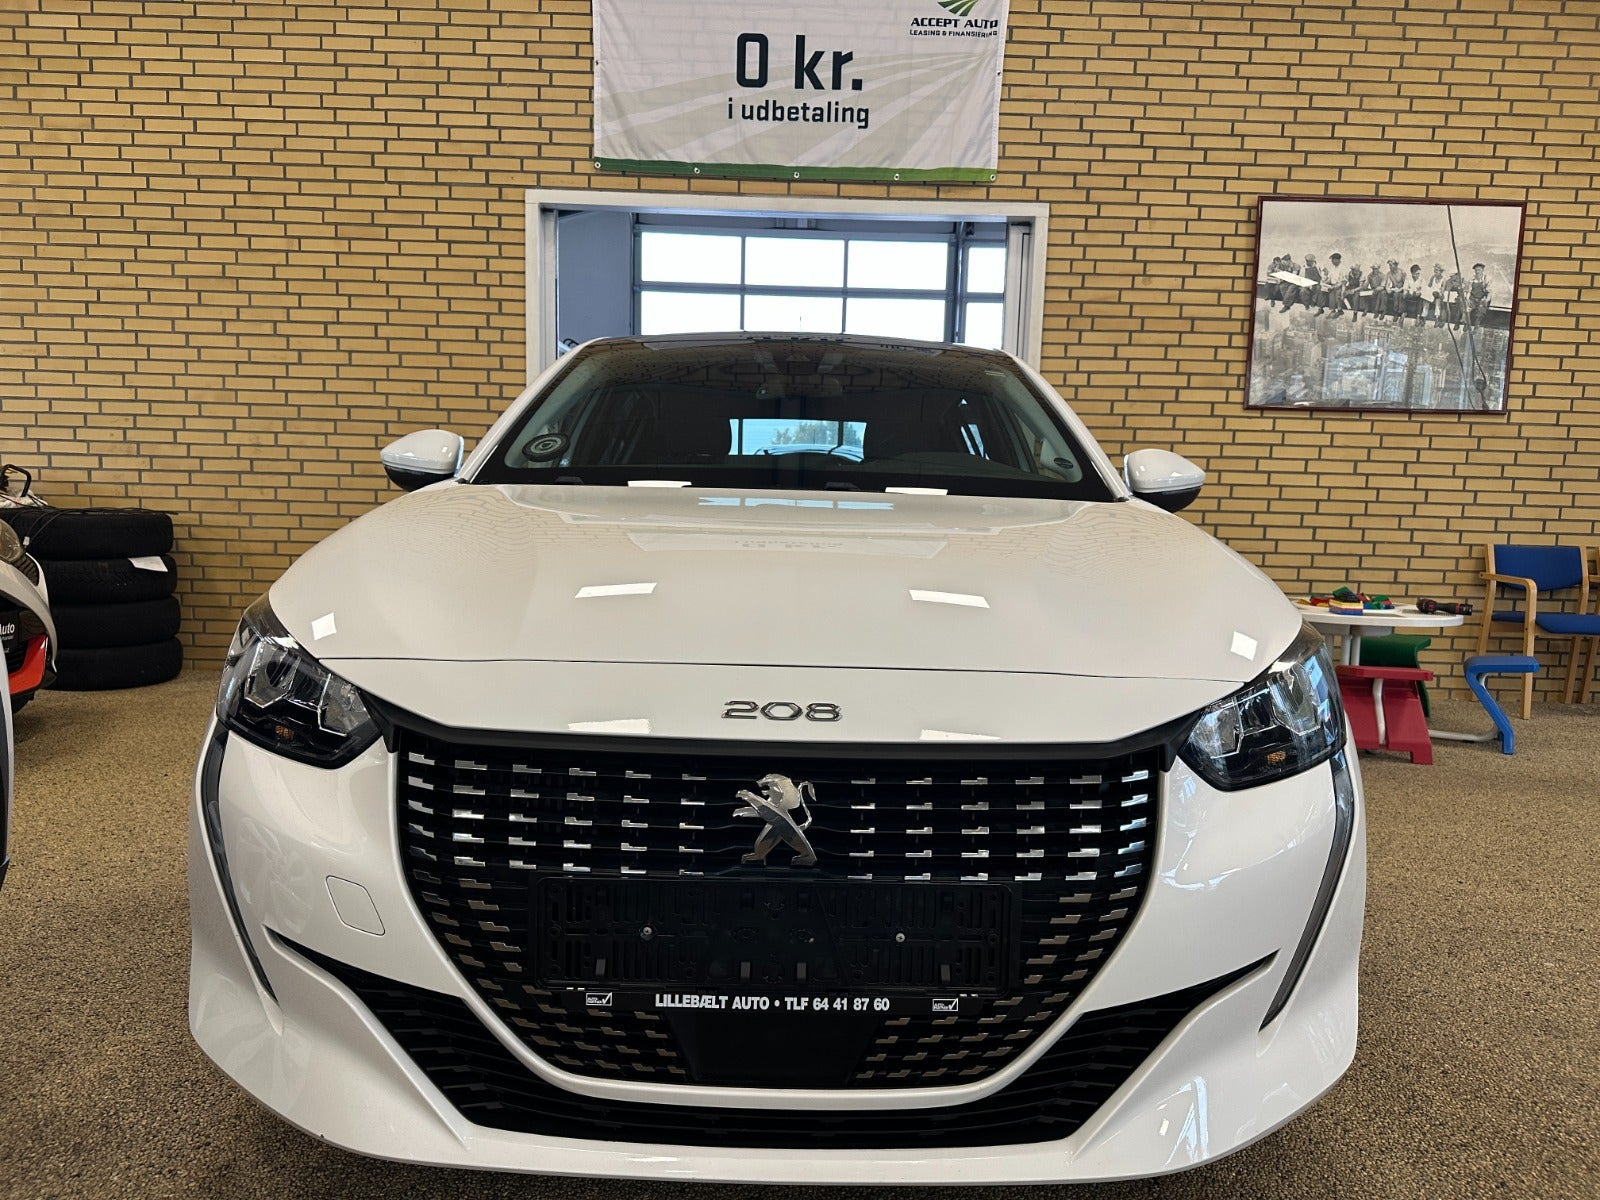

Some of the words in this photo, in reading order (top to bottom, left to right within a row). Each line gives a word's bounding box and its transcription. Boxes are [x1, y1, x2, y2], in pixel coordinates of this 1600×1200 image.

[910, 17, 961, 28] ACCEPT
[963, 18, 999, 29] AUTO
[948, 30, 998, 39] FINANSIERING
[736, 32, 769, 89] 0
[794, 34, 863, 91] kr.
[728, 97, 733, 120] i
[741, 99, 870, 130] udbetaling
[720, 700, 843, 723] 208
[655, 993, 729, 1009] LILLEBÆLT
[731, 996, 770, 1010] AUTO
[784, 996, 809, 1011] TLF
[812, 997, 830, 1011] 64
[832, 997, 848, 1011] 41
[853, 997, 870, 1011] 87
[873, 997, 890, 1011] 60
